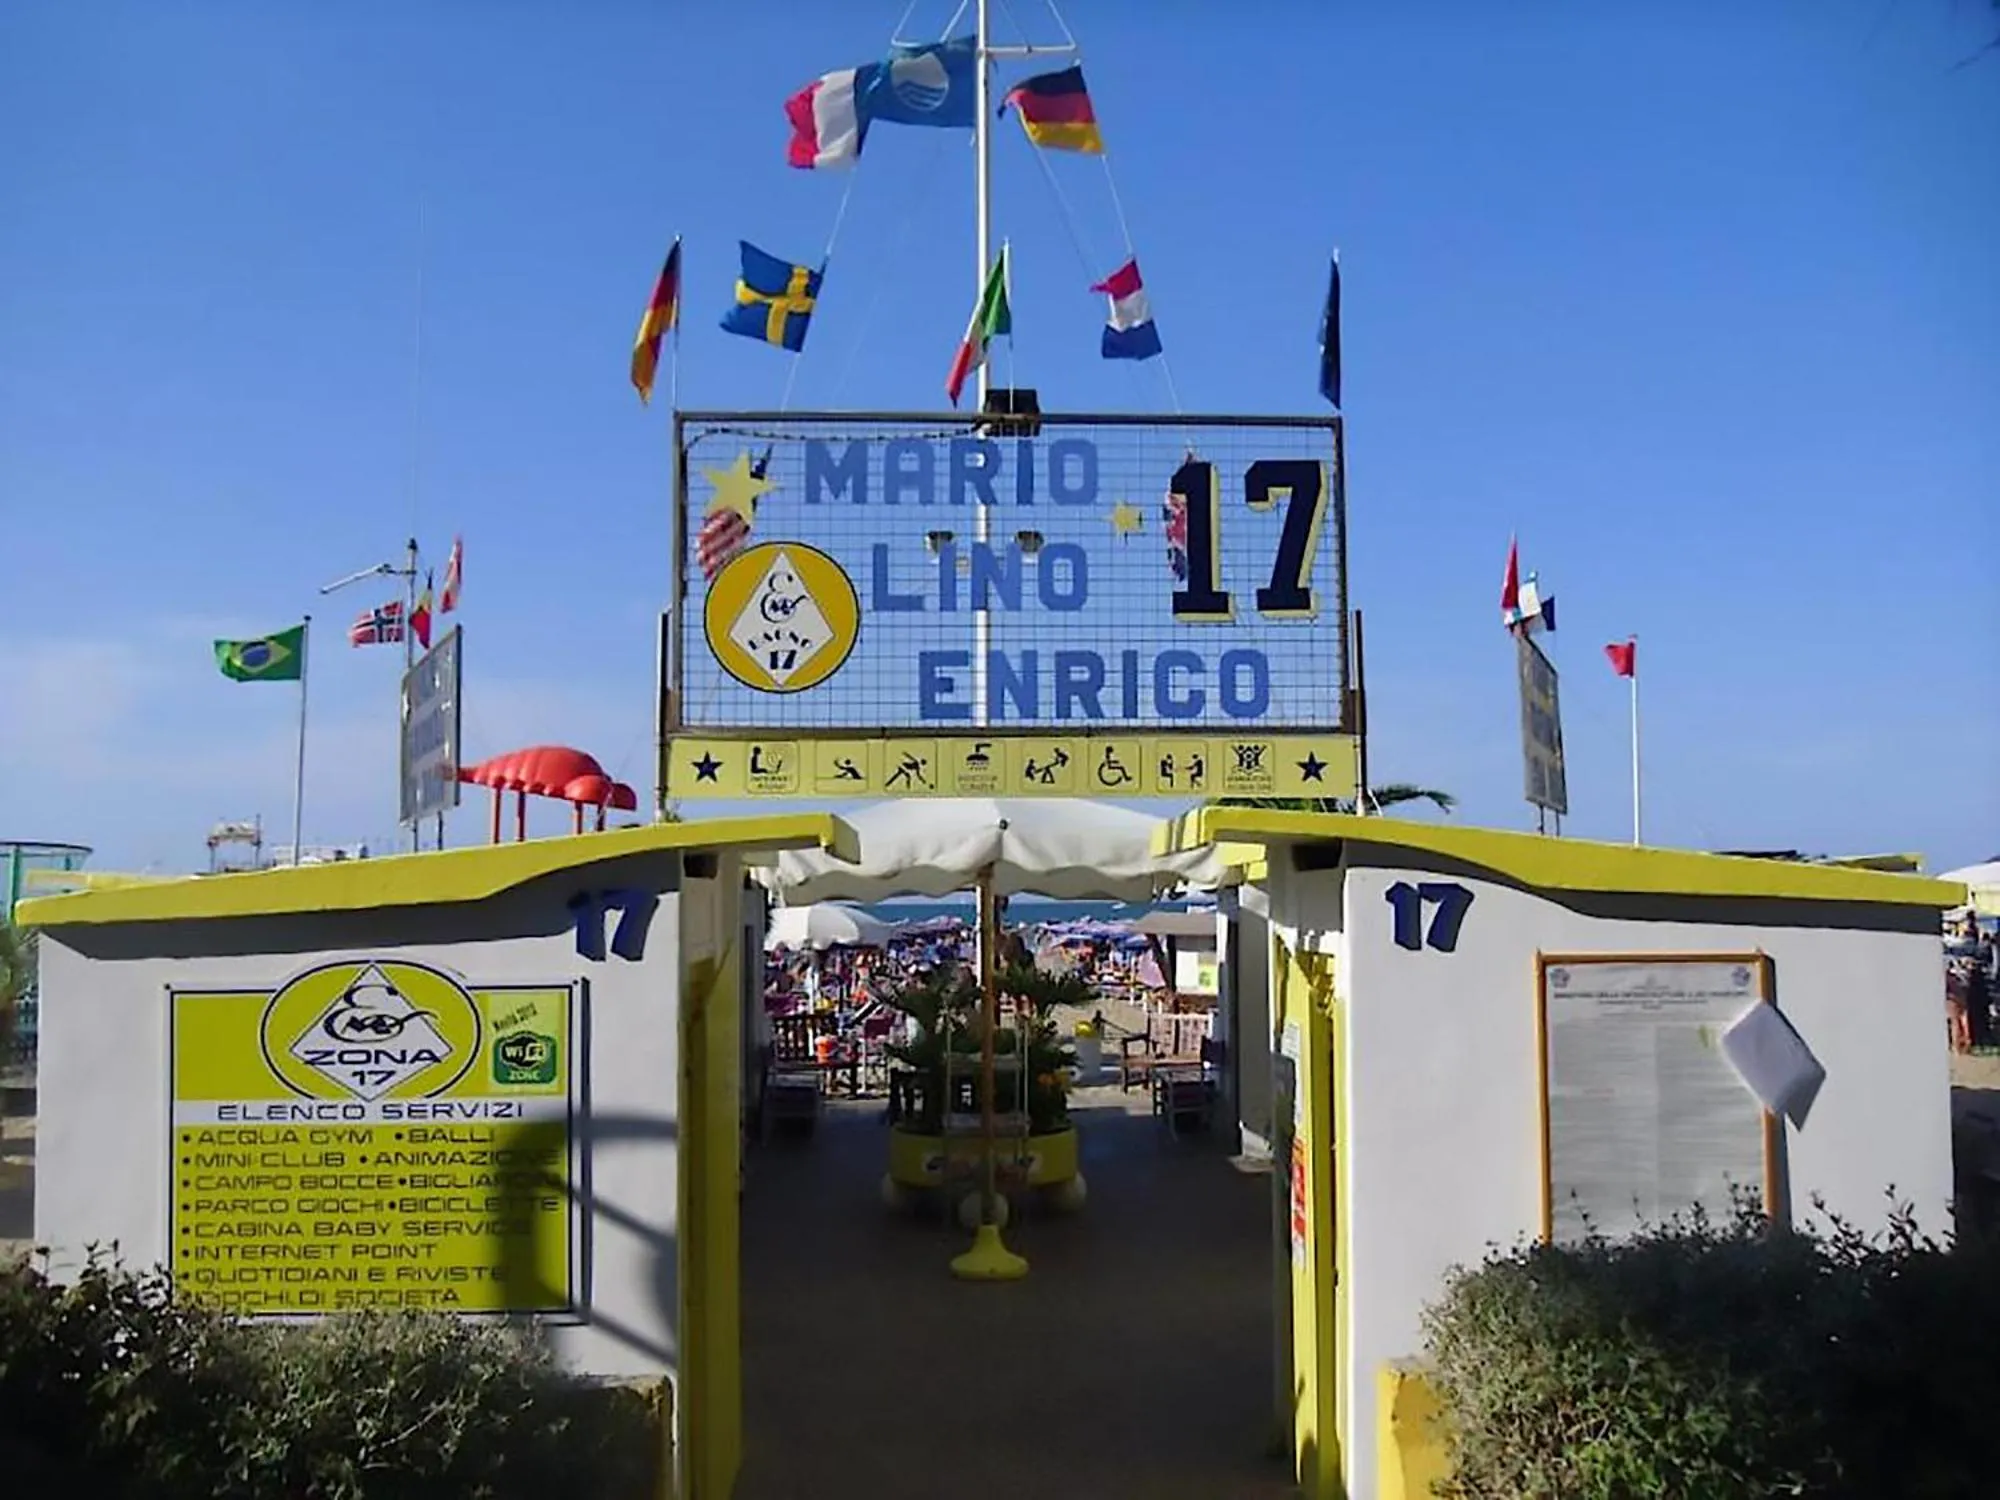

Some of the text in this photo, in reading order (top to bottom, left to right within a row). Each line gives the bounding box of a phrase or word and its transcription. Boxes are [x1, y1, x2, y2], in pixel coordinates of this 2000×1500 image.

[805, 439, 1098, 505] MARIO
[1170, 460, 1326, 624] 17
[872, 542, 1089, 612] LINO
[769, 649, 797, 670] 17
[918, 649, 1270, 720] ENRICO
[566, 889, 660, 962] 17
[1385, 881, 1475, 953] 17
[303, 1049, 442, 1065] ZONA
[352, 1070, 396, 1086] 17
[217, 1102, 523, 1120] ELENCO SERVIZI
[198, 1129, 374, 1145] ACQUA GYM
[408, 1128, 495, 1144] BALLI
[195, 1152, 345, 1168] MINI CLUB
[374, 1150, 561, 1167] ANIMAZIOE
[195, 1173, 394, 1191] CAMPO BOCCE
[195, 1198, 385, 1214] PARCO GIOCHI
[195, 1221, 304, 1238] CABINA
[314, 1220, 391, 1237] BABY
[195, 1243, 437, 1261] INTERNET POINT
[195, 1264, 506, 1288] QUOTIDIANI E RIVISTE
[298, 1289, 326, 1305] DI
